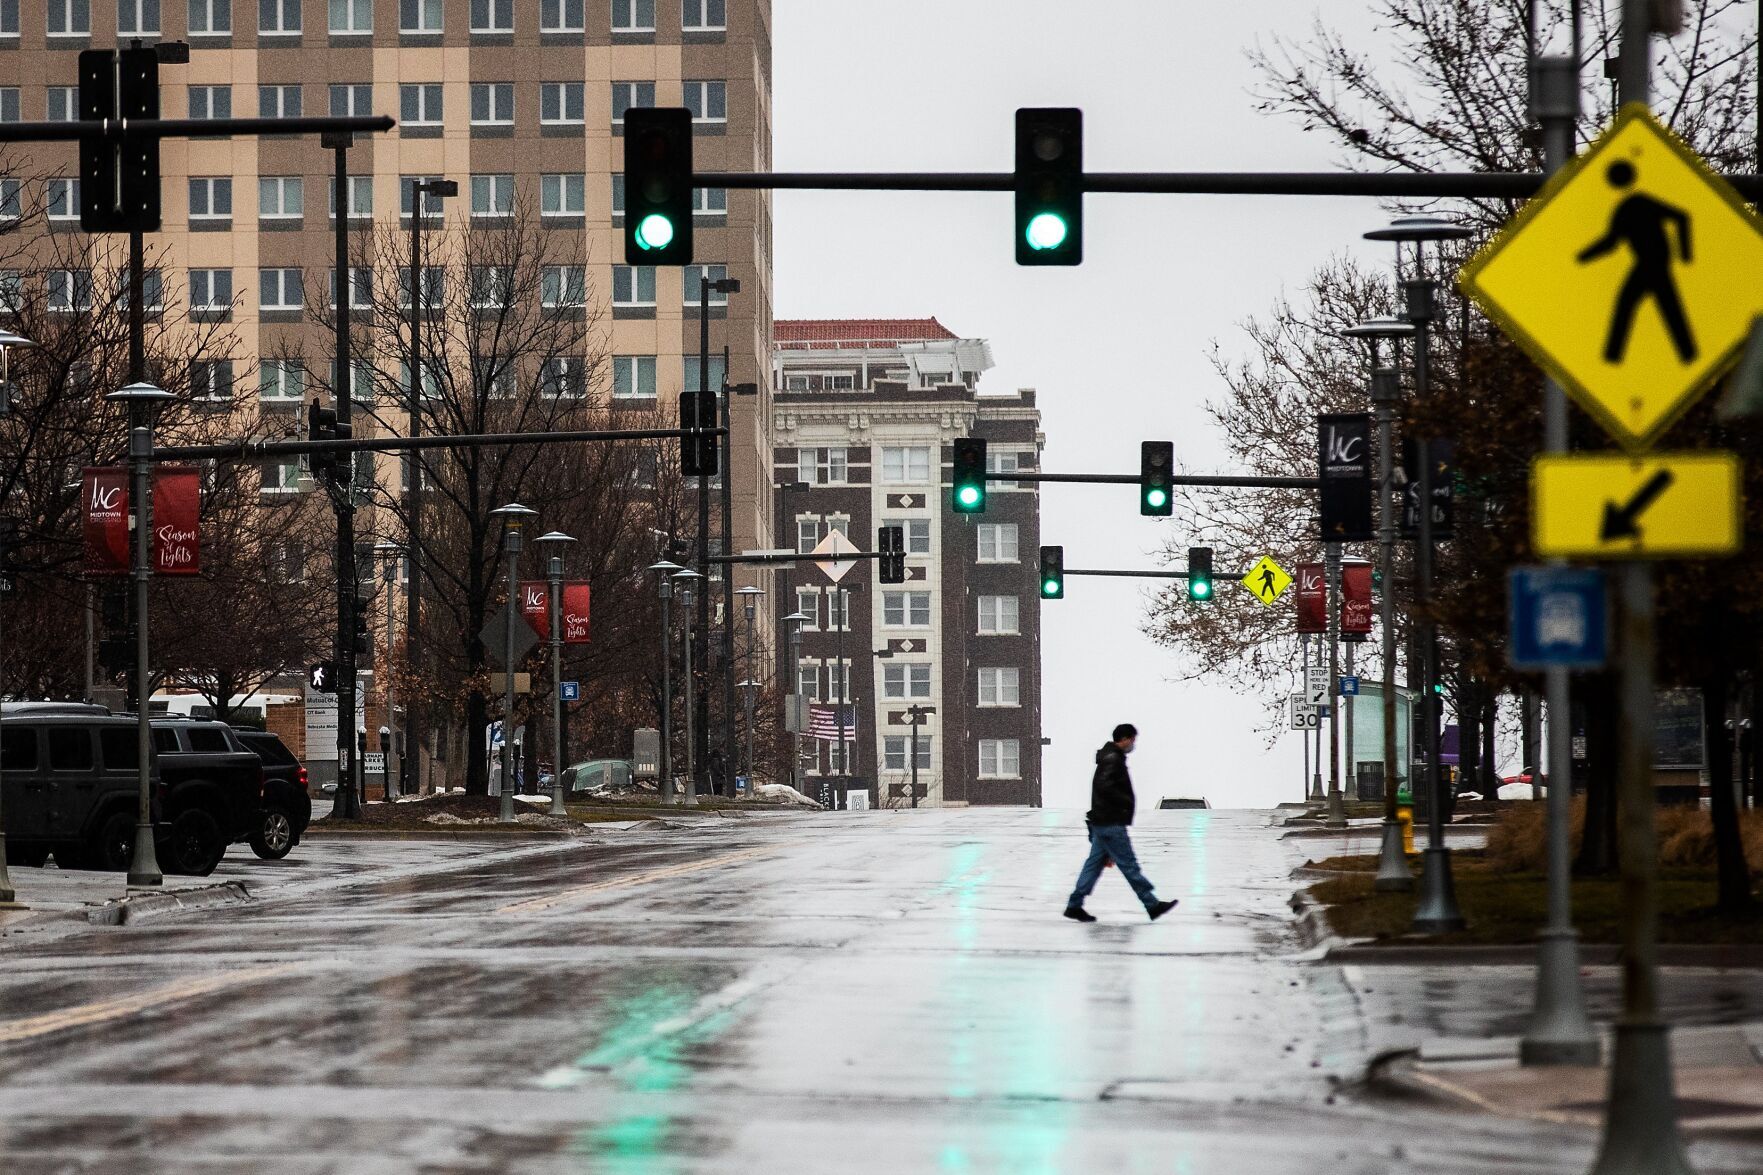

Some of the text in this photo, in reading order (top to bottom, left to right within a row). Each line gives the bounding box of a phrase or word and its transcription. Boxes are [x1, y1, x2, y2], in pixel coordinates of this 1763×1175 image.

[156, 525, 196, 546] Season
[160, 547, 192, 568] Lights
[565, 614, 589, 626] Season
[567, 626, 586, 639] Lights
[1295, 713, 1317, 727] 30
